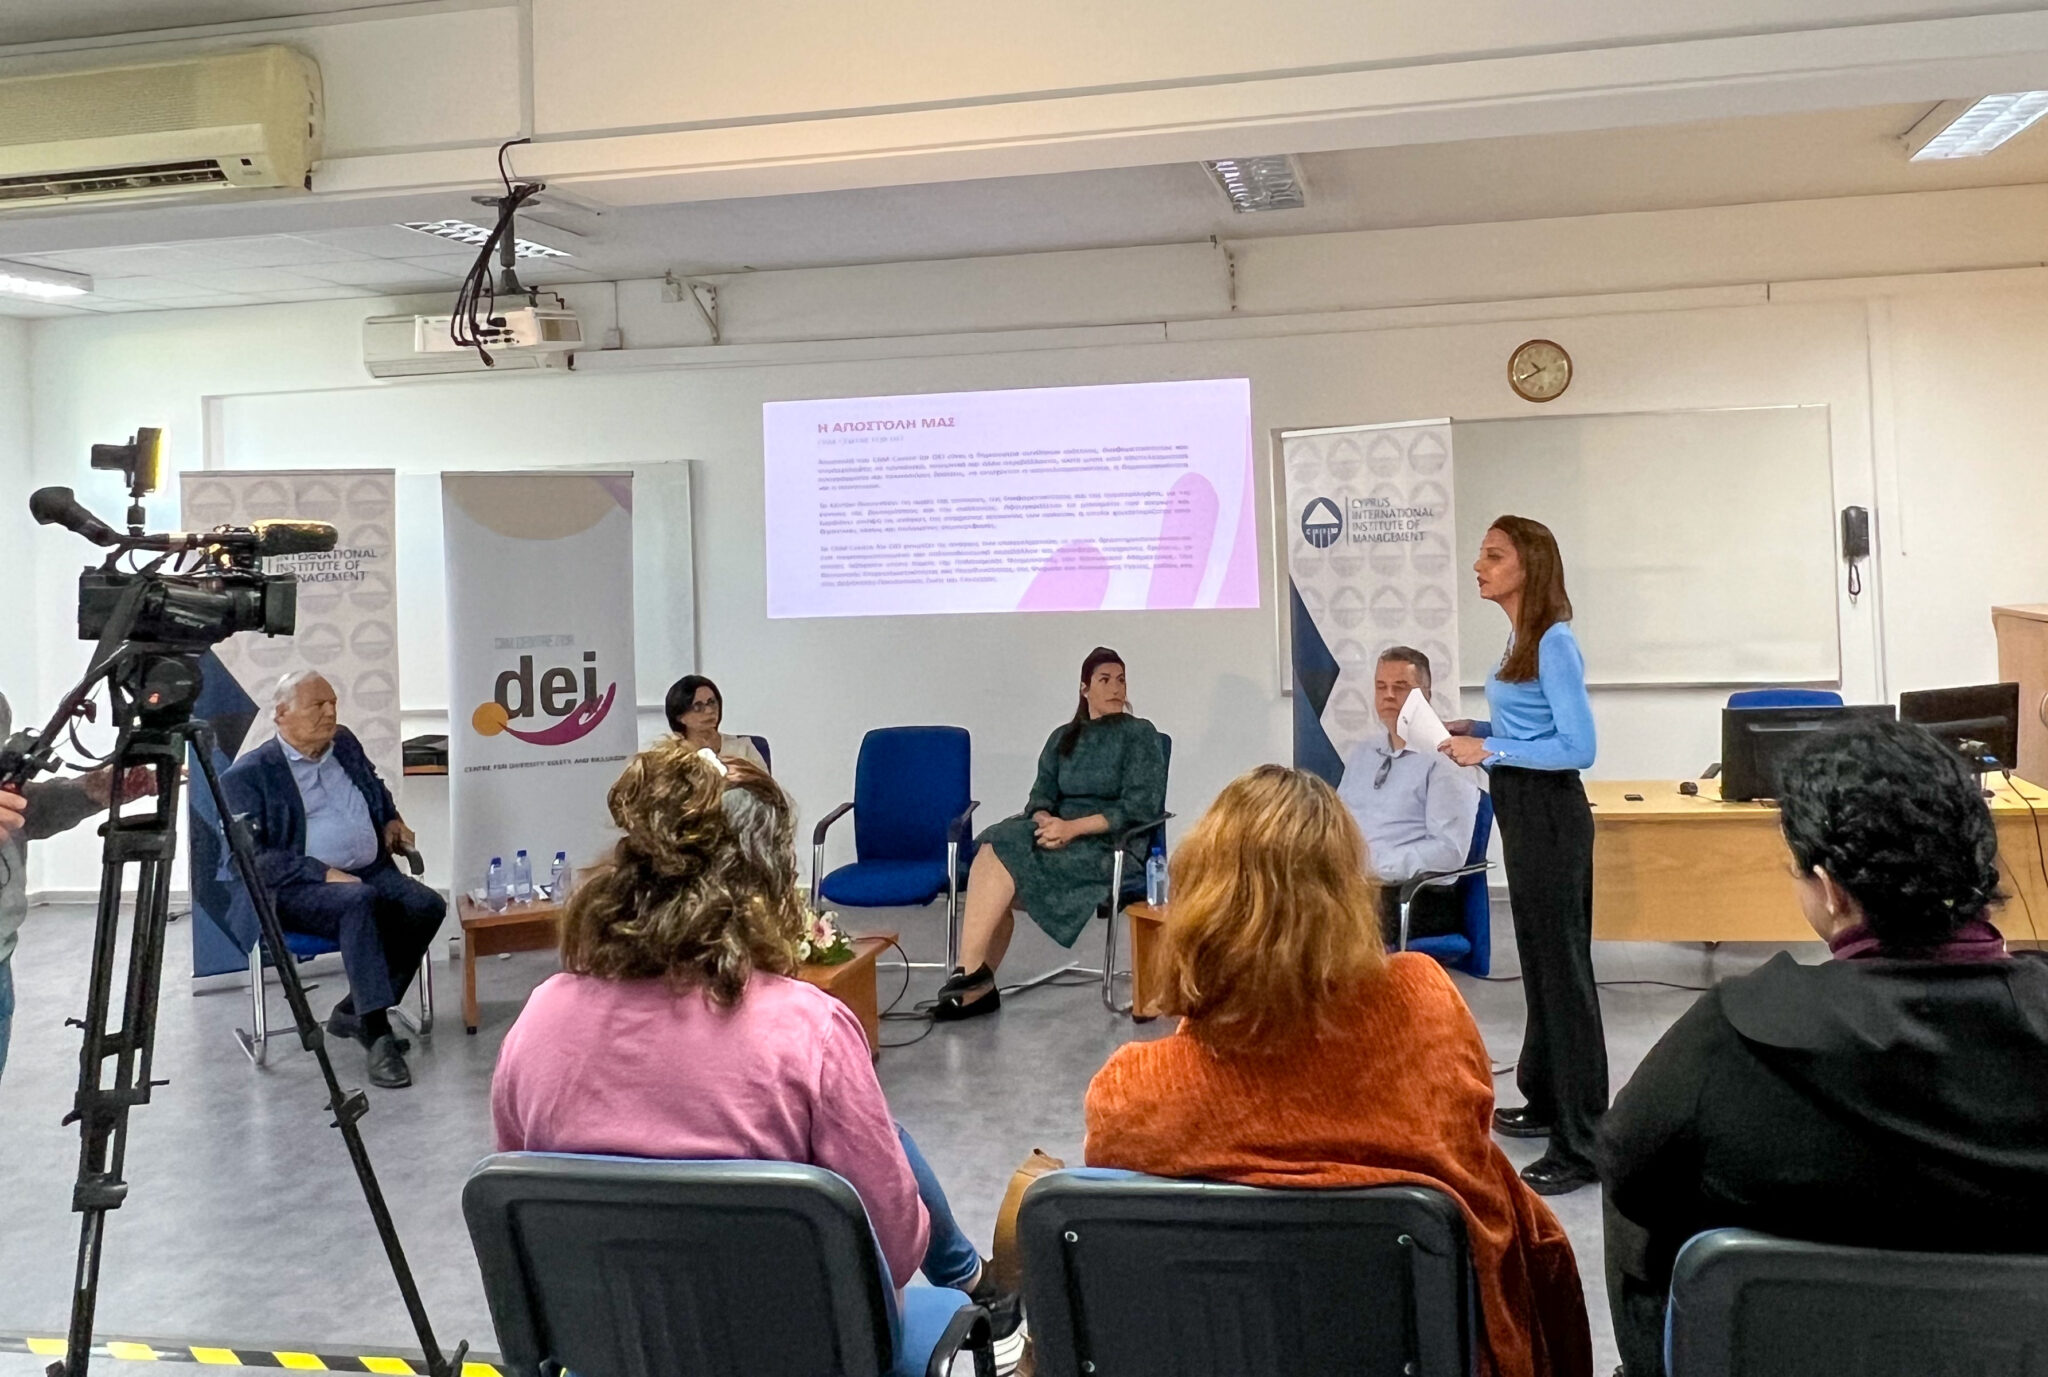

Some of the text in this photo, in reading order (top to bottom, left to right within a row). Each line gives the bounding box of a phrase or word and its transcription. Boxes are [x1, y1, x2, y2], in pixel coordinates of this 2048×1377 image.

[817, 416, 956, 434] Η ΑΠΟΣΤΟΛΗ ΜΑΣ
[1351, 497, 1390, 508] CYPRUS
[1351, 507, 1434, 520] INTERNATIONAL
[1352, 520, 1421, 531] INSTITUTE OF
[1352, 530, 1426, 543] MANAGEMENT
[276, 560, 360, 573] INSTITUTE OF
[297, 570, 367, 583] NAGEMENT
[494, 650, 598, 720] dei
